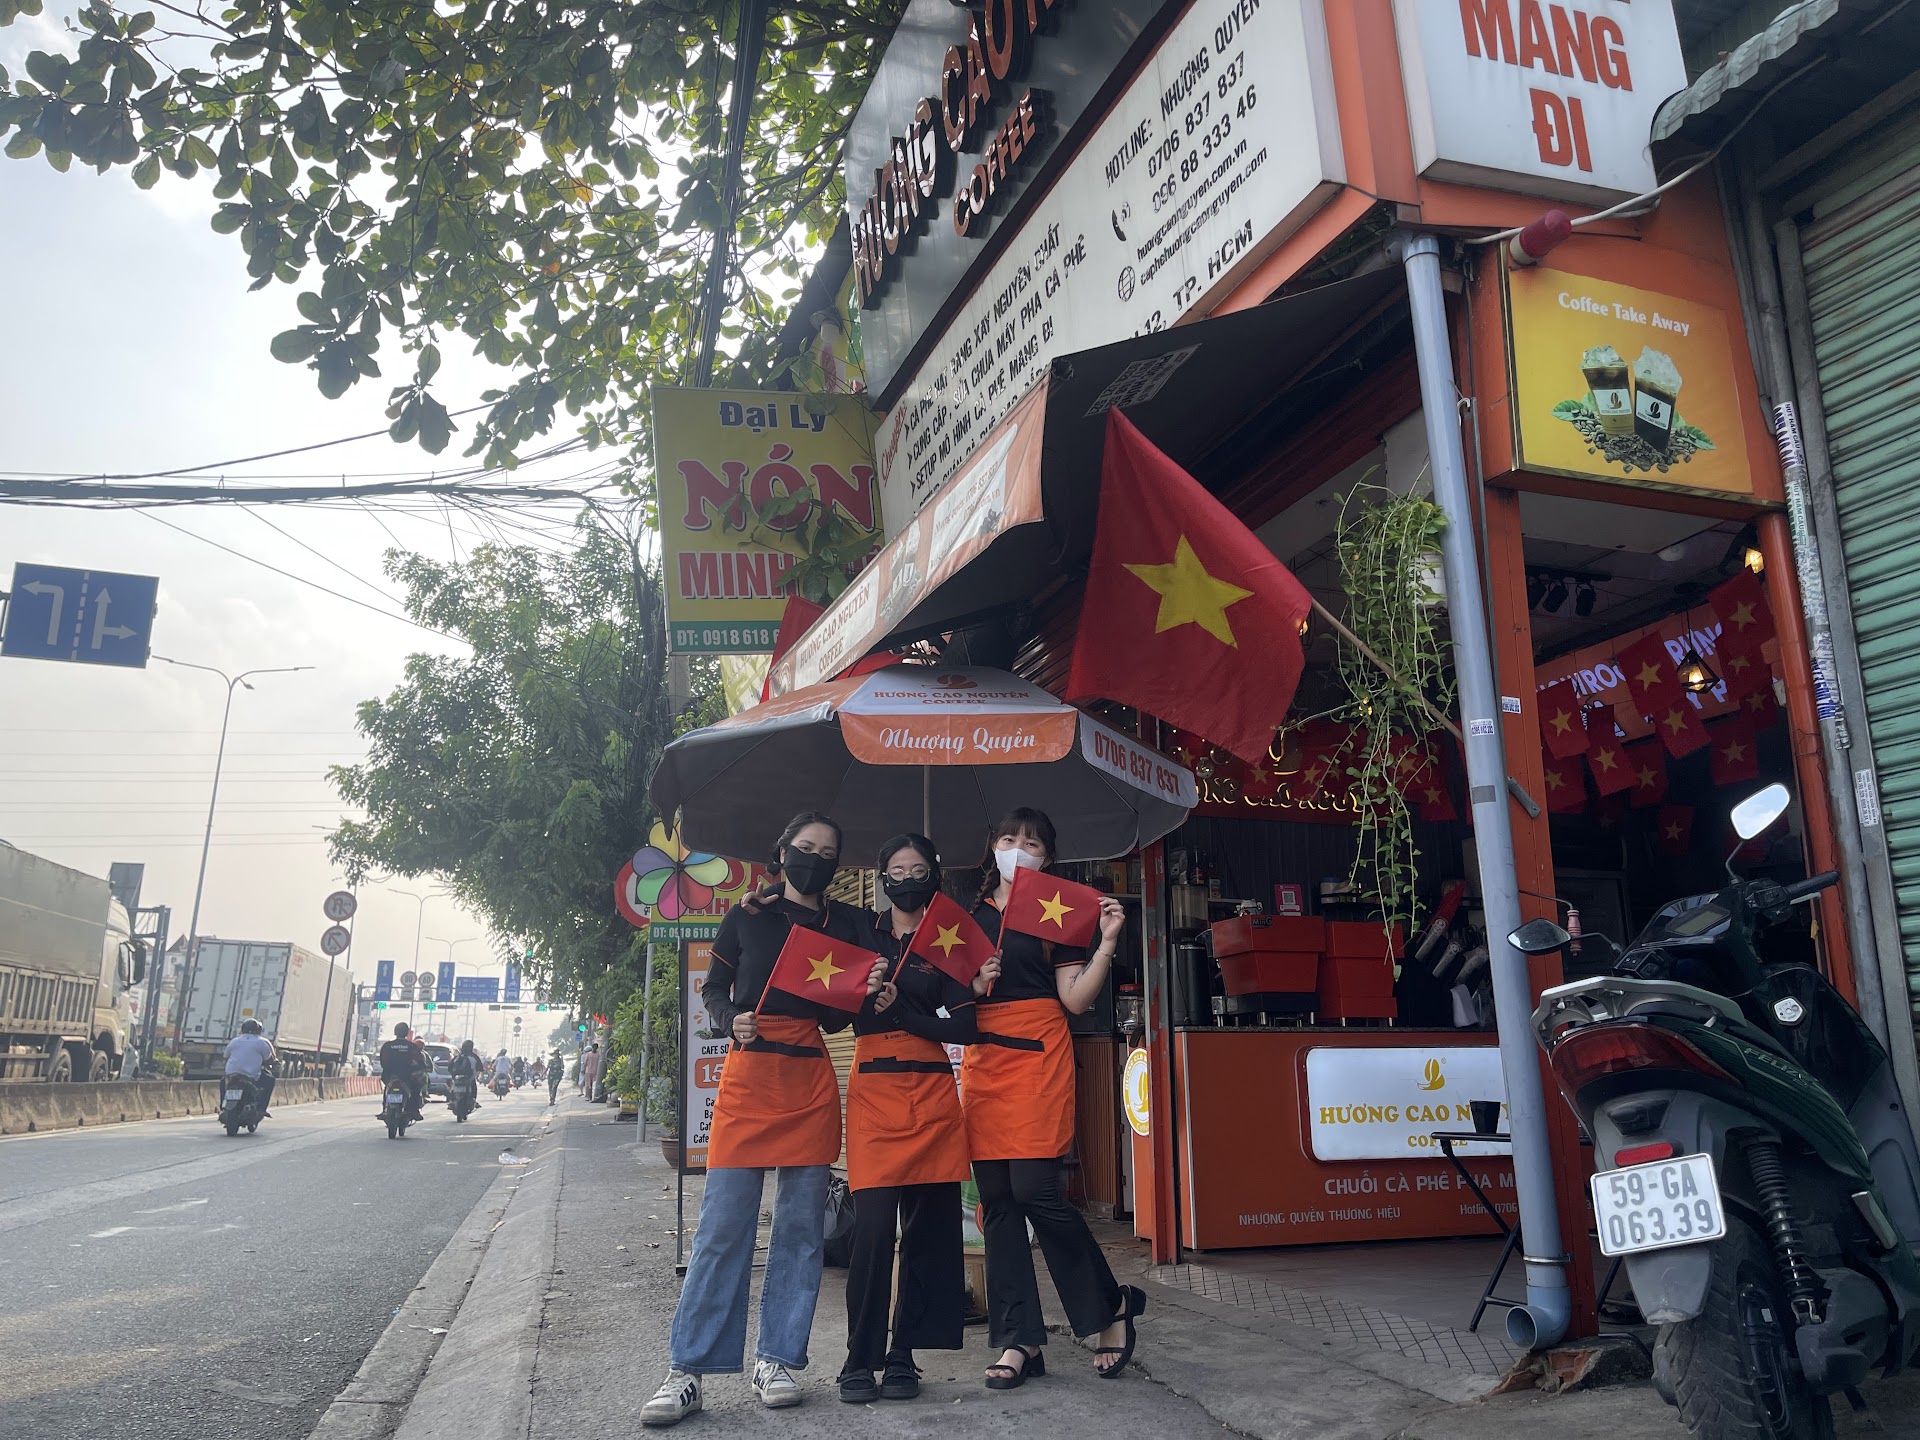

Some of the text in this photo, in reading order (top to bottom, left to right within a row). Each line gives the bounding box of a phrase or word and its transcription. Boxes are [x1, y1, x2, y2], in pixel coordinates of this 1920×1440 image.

[1458, 0, 1633, 92] MANG
[941, 0, 1013, 152] CAO
[1148, 51, 1244, 178] 0706 837 837
[1529, 88, 1593, 173] ĐI
[954, 87, 1036, 238] COFFEE
[1105, 117, 1153, 188] HOTLINE:
[1153, 84, 1257, 214] 096 88 333 46
[1136, 138, 1248, 262] huongcaonguyen.com.vn
[973, 310, 991, 348] XAY
[993, 260, 1032, 324] NGUYÊN
[1034, 222, 1060, 272] CHẤT
[1172, 275, 1202, 312] TP.
[1207, 218, 1253, 280] HCM
[1558, 292, 1690, 337] Coffee Take Away
[912, 426, 931, 461] CUNG
[996, 317, 1016, 360] MÁY
[1020, 290, 1042, 330] PHA
[1063, 233, 1087, 279] PHÊ
[719, 401, 779, 433] Đại
[915, 454, 937, 490] SETUP
[939, 433, 950, 463] MÔ
[952, 410, 972, 447] HÌNH
[988, 367, 1007, 404] PHÊ
[1008, 334, 1039, 382] MANG
[677, 443, 877, 533] NÓN
[678, 552, 800, 599] MINH
[703, 629, 739, 646] 0918
[742, 628, 770, 646] 618
[822, 618, 837, 645] CAO
[838, 583, 870, 630] NGUYÊN
[818, 636, 844, 675] COFFEE
[968, 690, 1029, 699] NGUYÊN
[879, 727, 1037, 755] Nhượng Quyền
[1094, 730, 1126, 772] 0706
[1130, 750, 1153, 785] 837
[1156, 764, 1180, 797] 837
[668, 927, 691, 938] 0918
[693, 927, 709, 938] 618
[422, 976, 430, 984] 60
[702, 1045, 719, 1055] CAFE
[1319, 1103, 1400, 1124] HƯƠNG
[1405, 1105, 1450, 1122] CAO
[1324, 1170, 1378, 1195] CHUỖI
[1385, 1173, 1410, 1193] CÀ
[1416, 1170, 1450, 1191] PHÊ
[1609, 1162, 1699, 1209] 59-GA
[1239, 1211, 1285, 1228] NHƯỢNG
[1377, 1205, 1401, 1220] HIỆU
[1495, 1202, 1518, 1214] 0706
[1608, 1199, 1715, 1249] 063.39
